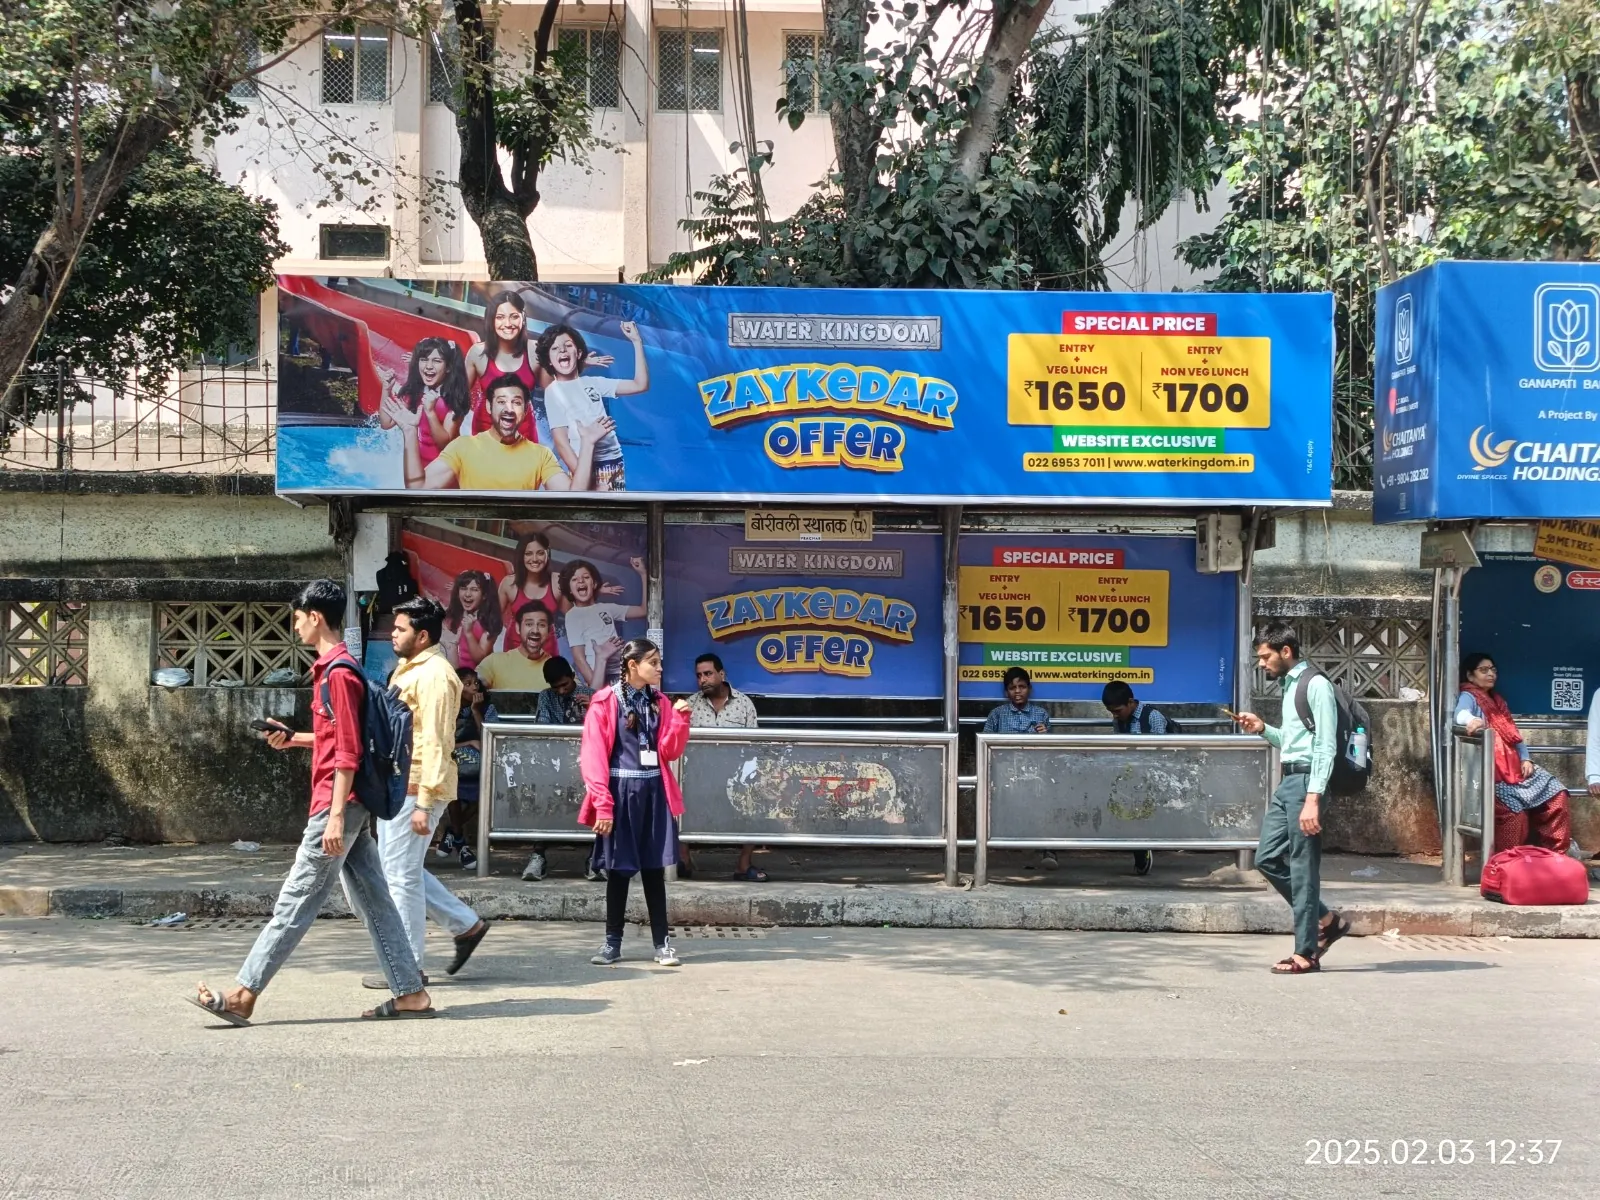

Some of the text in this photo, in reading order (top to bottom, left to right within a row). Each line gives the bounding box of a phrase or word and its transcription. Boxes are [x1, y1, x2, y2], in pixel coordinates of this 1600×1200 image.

[1074, 316, 1205, 332] SPECIAL PRICE
[739, 321, 931, 342] WATER KINGDOM
[1059, 344, 1095, 353] ENTRY
[1187, 346, 1222, 355] ENTRY
[1046, 365, 1107, 374] VEG LUNCH
[1161, 367, 1249, 377] NON VEG LUNCH
[1518, 379, 1600, 390] GANAPATI BA
[1024, 380, 1126, 411] ₹1650
[1152, 382, 1249, 413] ₹1700
[1538, 410, 1598, 421] A Project By
[1061, 434, 1216, 448] WEBSITE EXCLUSIVE
[1027, 457, 1049, 468] 022
[1051, 457, 1080, 468] 6953
[1083, 457, 1105, 468] 7011
[1113, 457, 1250, 470] www.waterkingdom.in
[1512, 466, 1600, 481] HOLDING
[751, 513, 801, 532] बोरीवली
[802, 517, 848, 533] स्थानक
[1559, 519, 1600, 539] PARKIN
[1556, 536, 1594, 552] METRES
[737, 552, 894, 571] WATER KINGDOM
[1003, 552, 1114, 565] SPECIAL PRICE
[989, 575, 1020, 583] ENTRY
[1098, 577, 1129, 585] ENTRY
[978, 593, 1031, 601] VEG LUNCH
[1076, 594, 1150, 603] NON VEG LUNCH
[990, 650, 1122, 663] WEBSITE EXCLUSIVE
[962, 670, 980, 678] 022
[1034, 670, 1150, 681] www.waterkingdom.in
